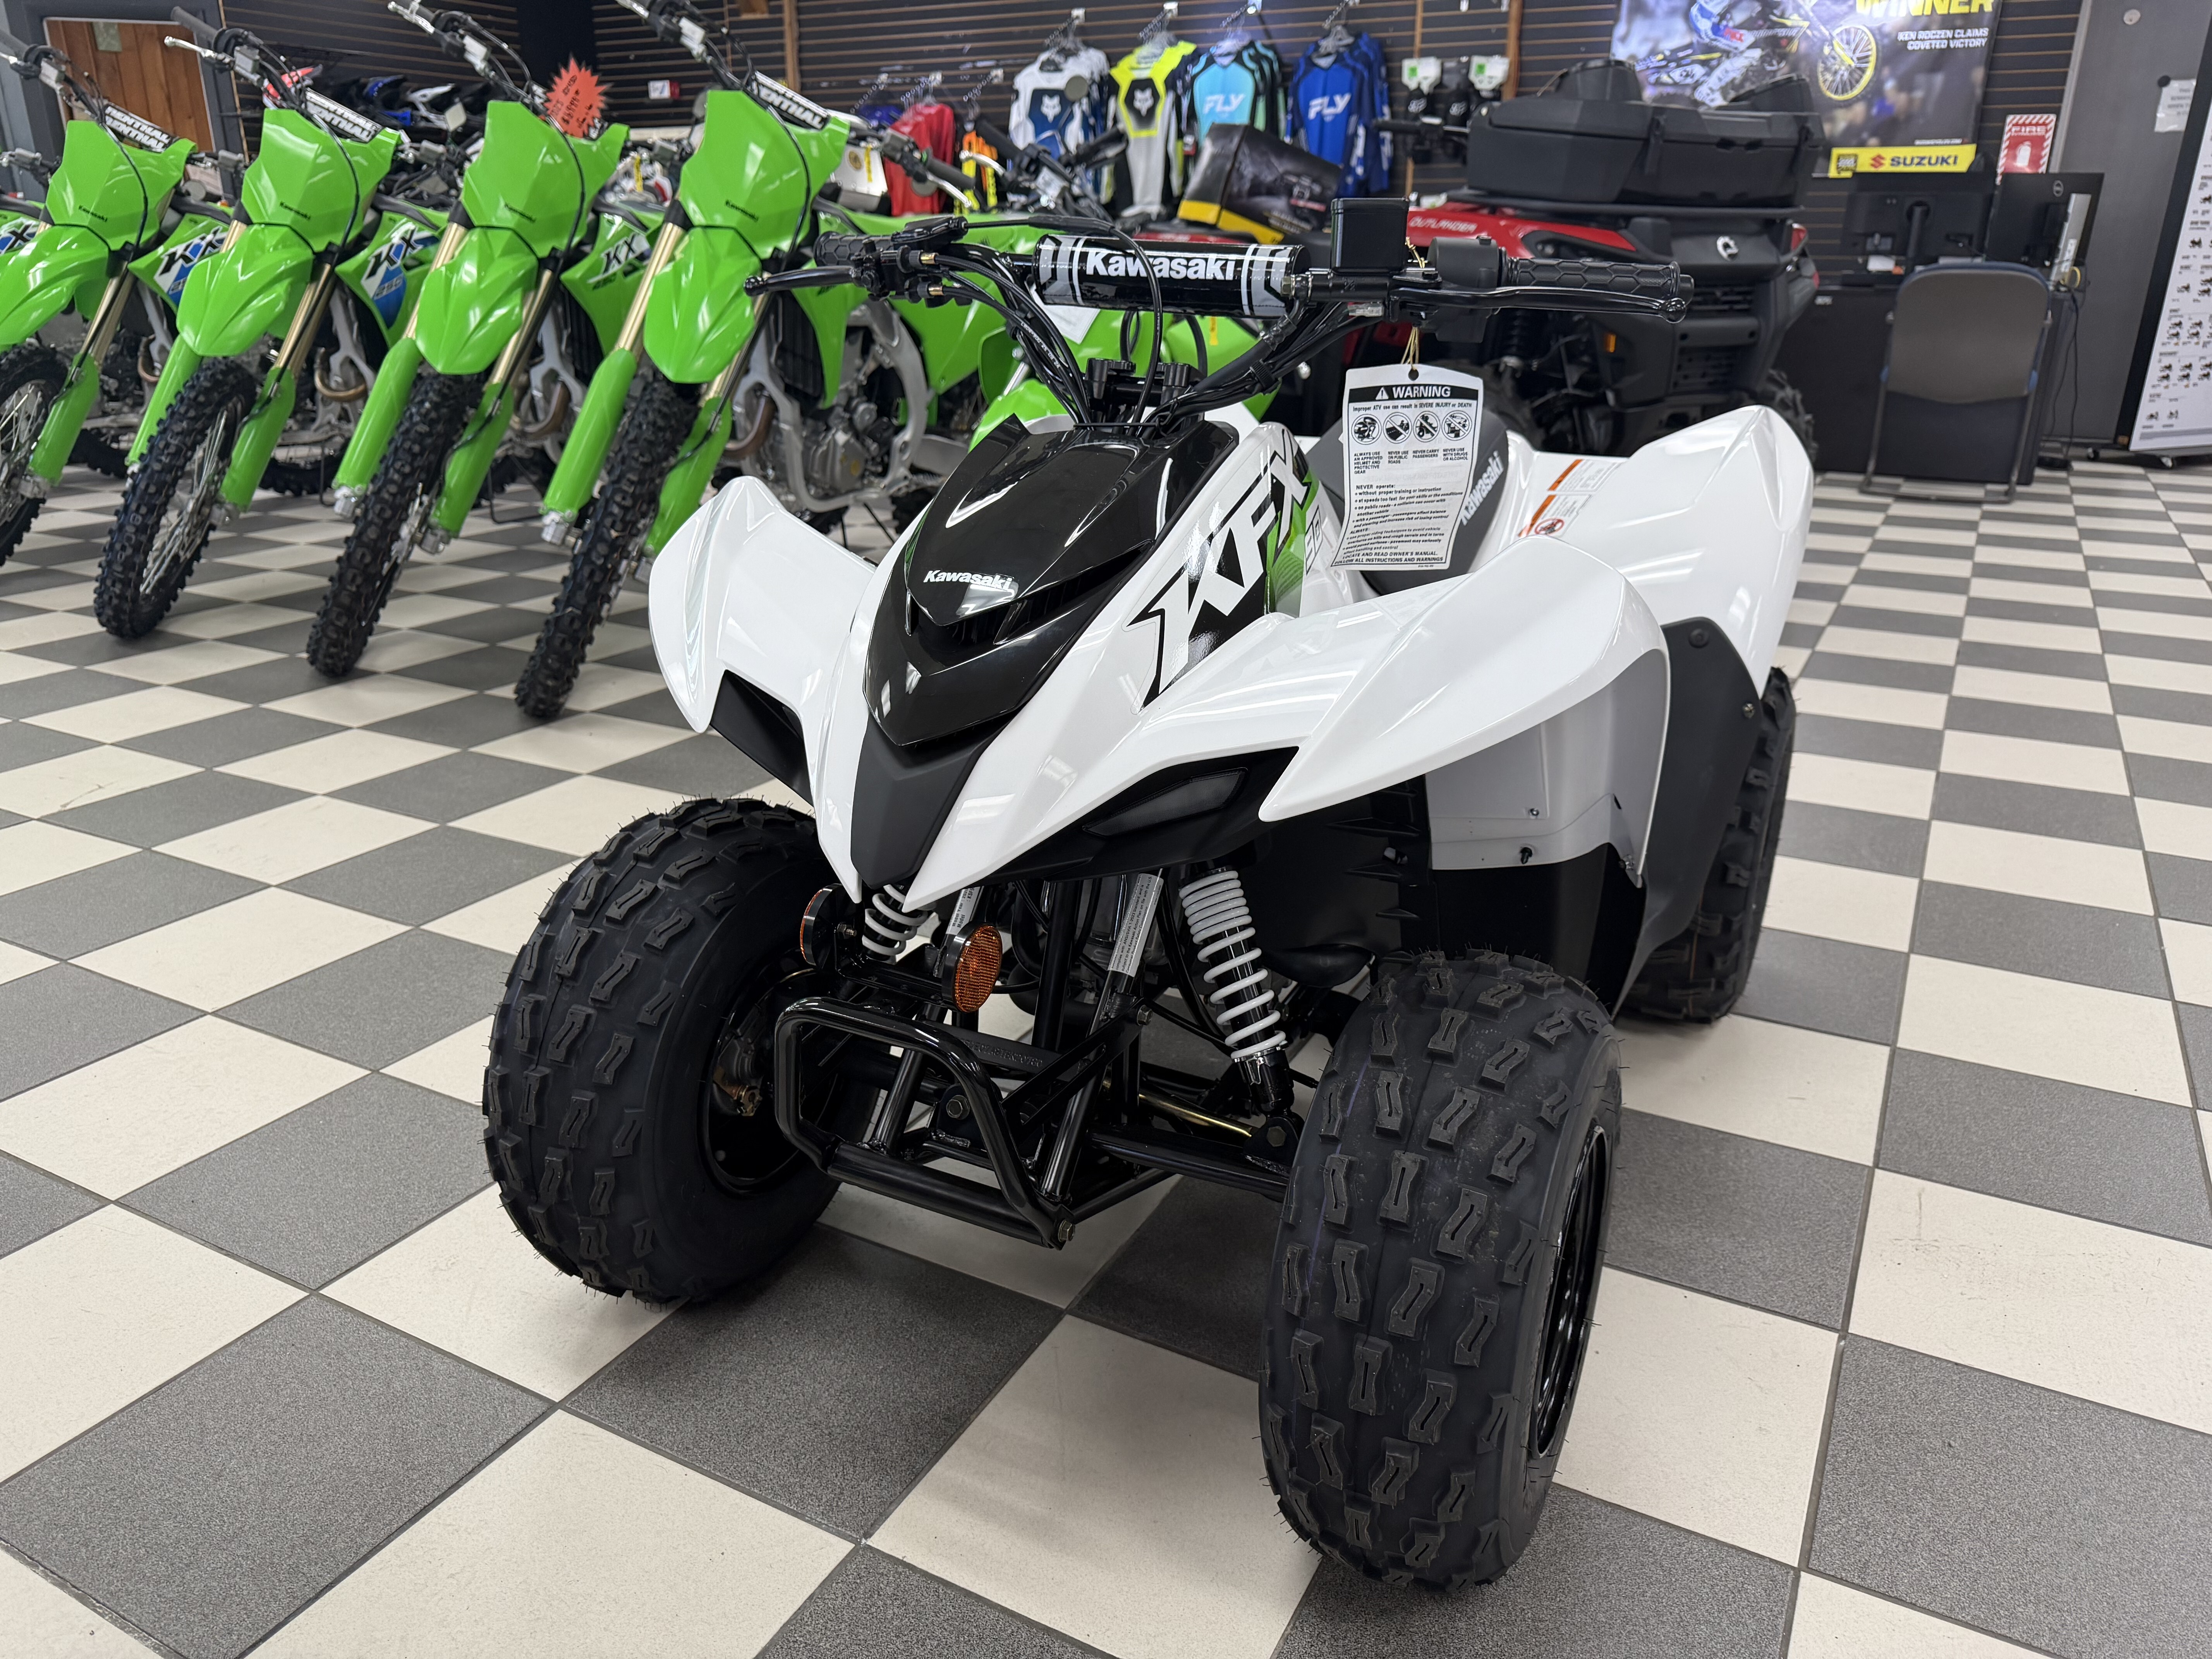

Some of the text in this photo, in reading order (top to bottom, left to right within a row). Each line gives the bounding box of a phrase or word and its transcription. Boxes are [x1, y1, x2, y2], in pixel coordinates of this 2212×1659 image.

[1898, 31, 1917, 41] KEN
[1954, 28, 1989, 38] CLAIMS
[1907, 38, 1988, 50] COVETED VICTORY
[1203, 94, 1245, 114] FLY
[1308, 93, 1351, 120] FLY
[1890, 155, 1958, 167] SUZUKI
[1408, 216, 1478, 233] OUTLANDER
[366, 226, 416, 279] KX
[603, 233, 636, 274] KX
[1086, 251, 1237, 280] Kawasaki
[1393, 386, 1451, 398] WARNING
[923, 570, 1012, 591] Kawasaki
[957, 914, 965, 928] Model
